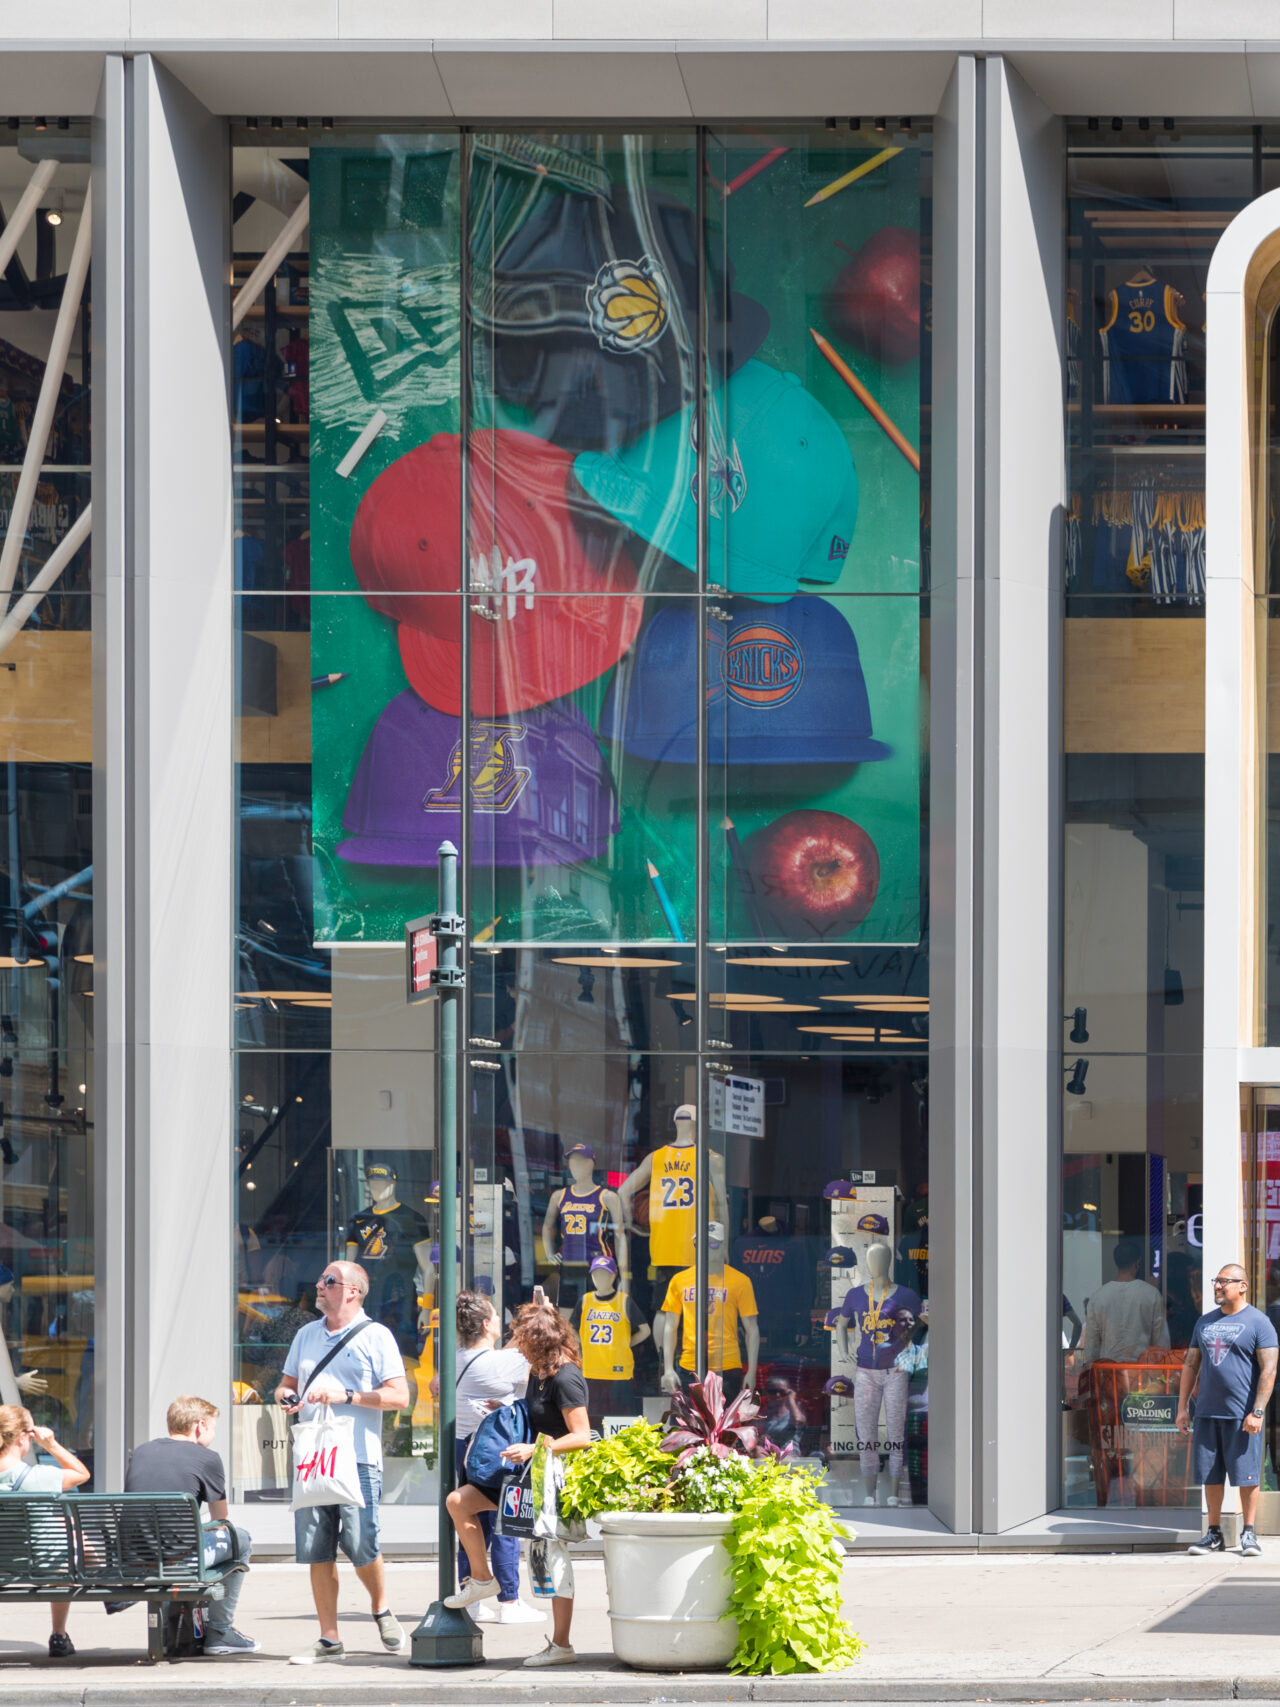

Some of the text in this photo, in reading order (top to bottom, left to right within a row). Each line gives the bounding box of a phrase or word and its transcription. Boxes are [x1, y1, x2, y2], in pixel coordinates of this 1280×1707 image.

[1128, 311, 1155, 333] 30
[726, 644, 798, 685] KNICKS
[663, 1159, 691, 1173] JAMES
[660, 1176, 695, 1210] 23
[564, 1214, 587, 1235] 23
[586, 1309, 621, 1323] LAKERS
[590, 1324, 613, 1345] 23
[1126, 1407, 1172, 1419] SPALDING
[262, 1439, 287, 1450] PUT
[856, 1441, 881, 1451] CAP
[883, 1440, 901, 1451] ON
